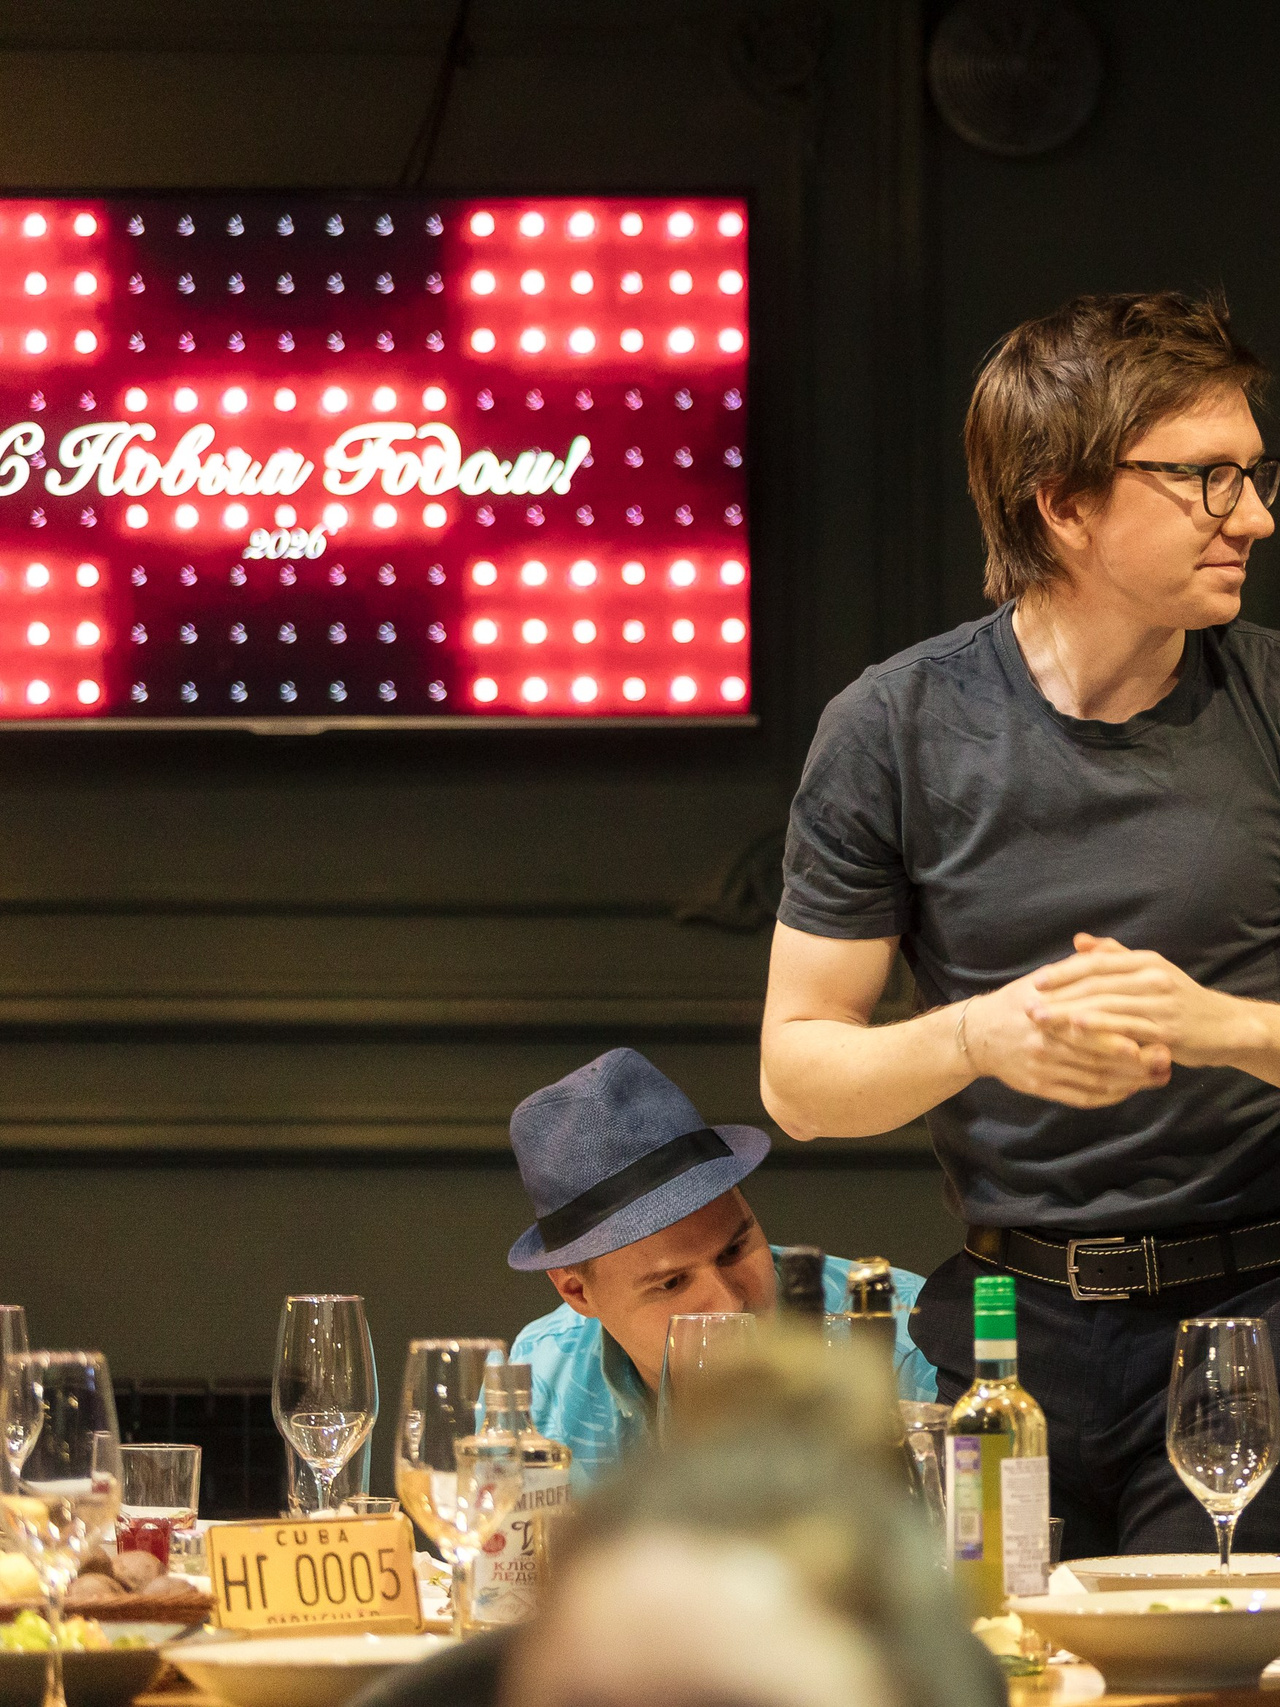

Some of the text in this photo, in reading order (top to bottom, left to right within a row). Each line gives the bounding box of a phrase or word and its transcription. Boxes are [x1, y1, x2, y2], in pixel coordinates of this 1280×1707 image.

[45, 422, 314, 497] Новым
[322, 422, 591, 496] Годом!
[242, 523, 338, 560] 2026
[275, 1529, 350, 1547] CUBA
[296, 1548, 401, 1607] 0005
[494, 1561, 536, 1572] КЛЮ
